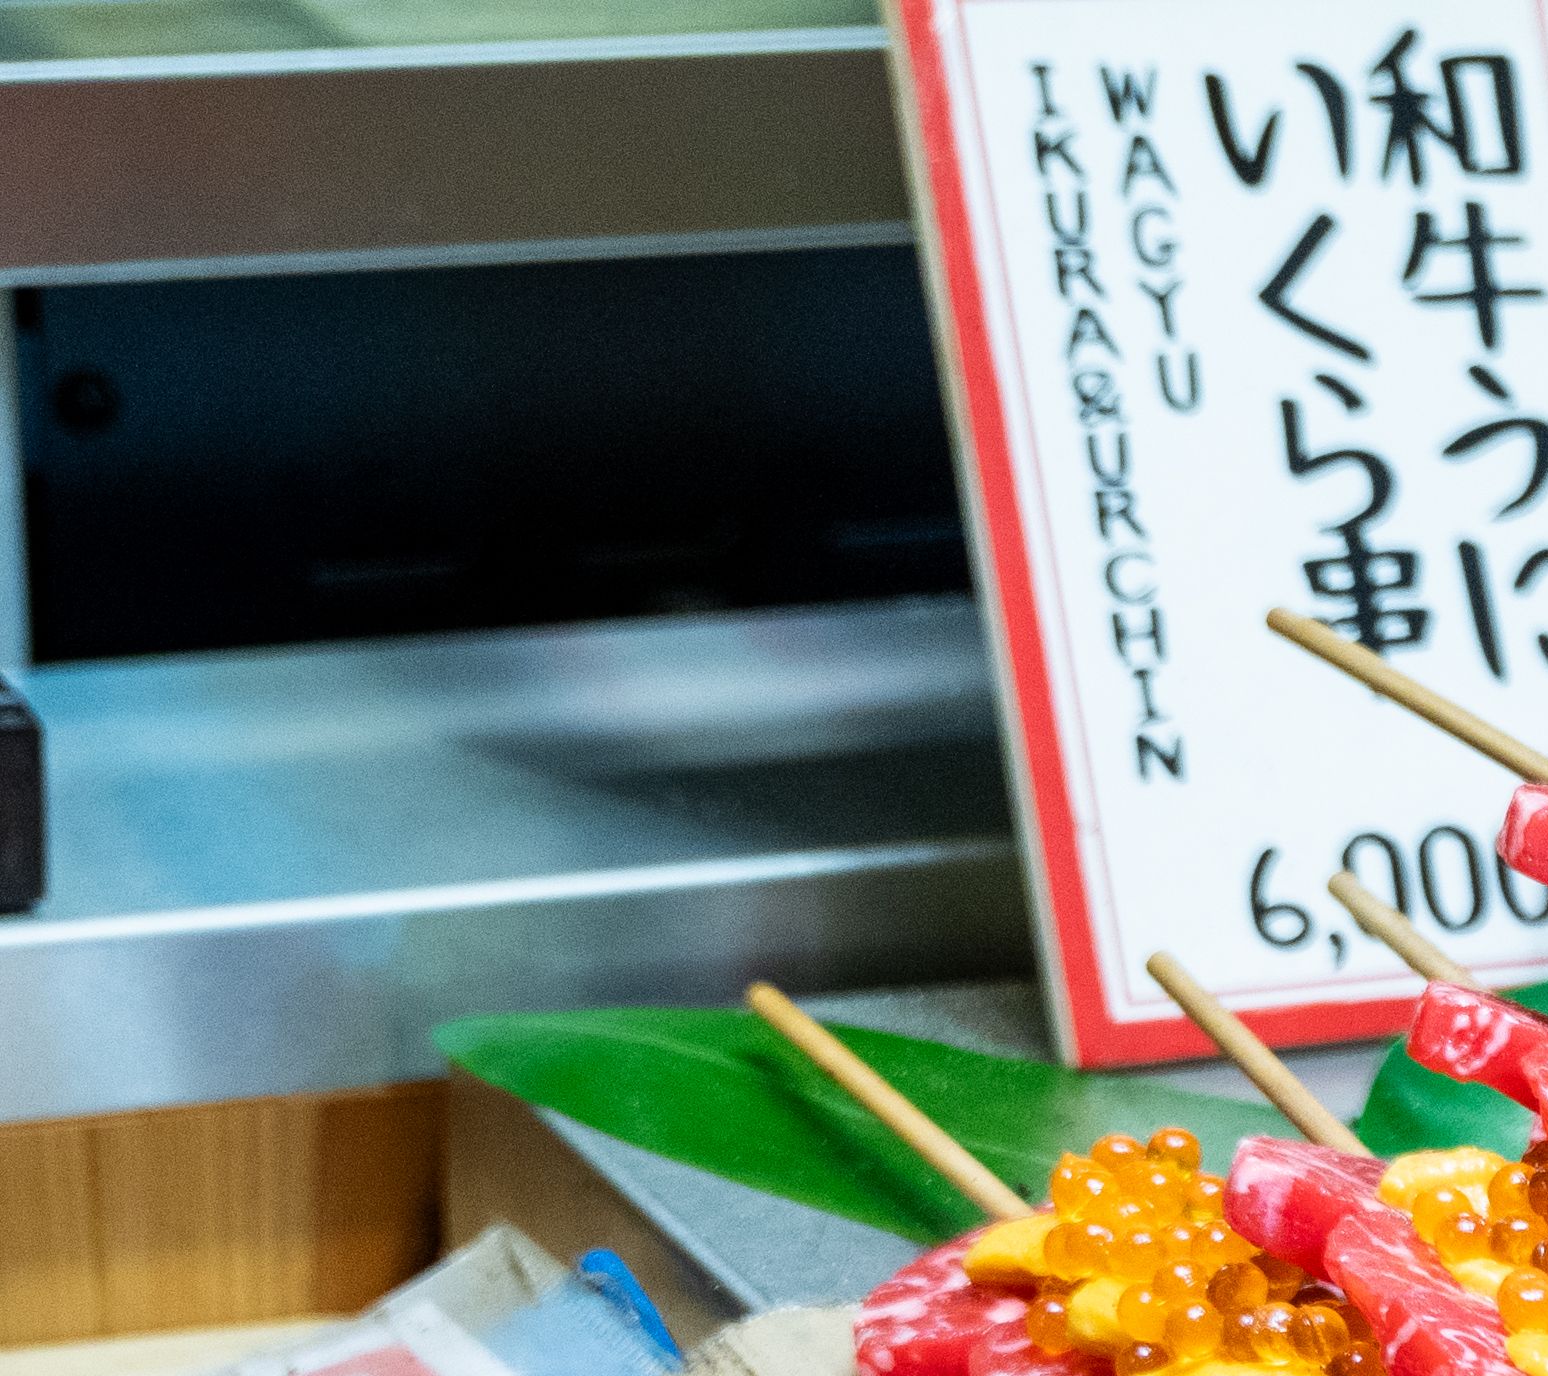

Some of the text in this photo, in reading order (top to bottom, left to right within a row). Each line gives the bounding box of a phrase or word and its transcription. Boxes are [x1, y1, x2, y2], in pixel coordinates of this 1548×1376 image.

[1099, 65, 1202, 413] WAGYU
[1203, 62, 1432, 697] いくら串
